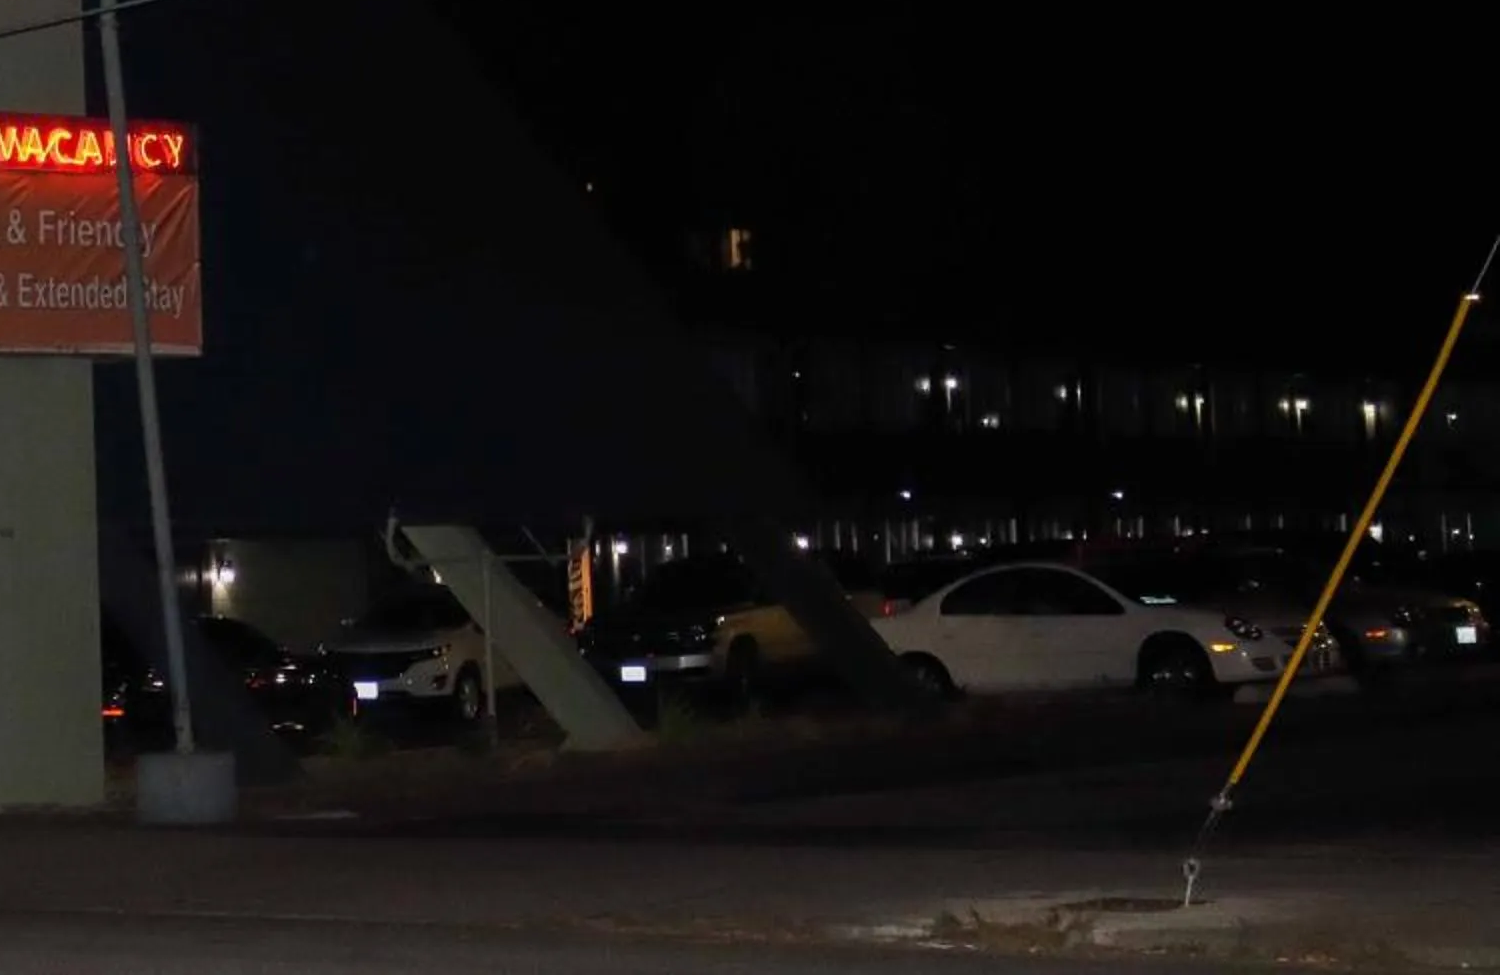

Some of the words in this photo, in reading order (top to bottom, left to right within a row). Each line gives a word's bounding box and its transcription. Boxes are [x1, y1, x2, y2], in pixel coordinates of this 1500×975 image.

[7, 208, 27, 245] &
[38, 210, 157, 258] Frieny
[18, 273, 127, 310] Extended
